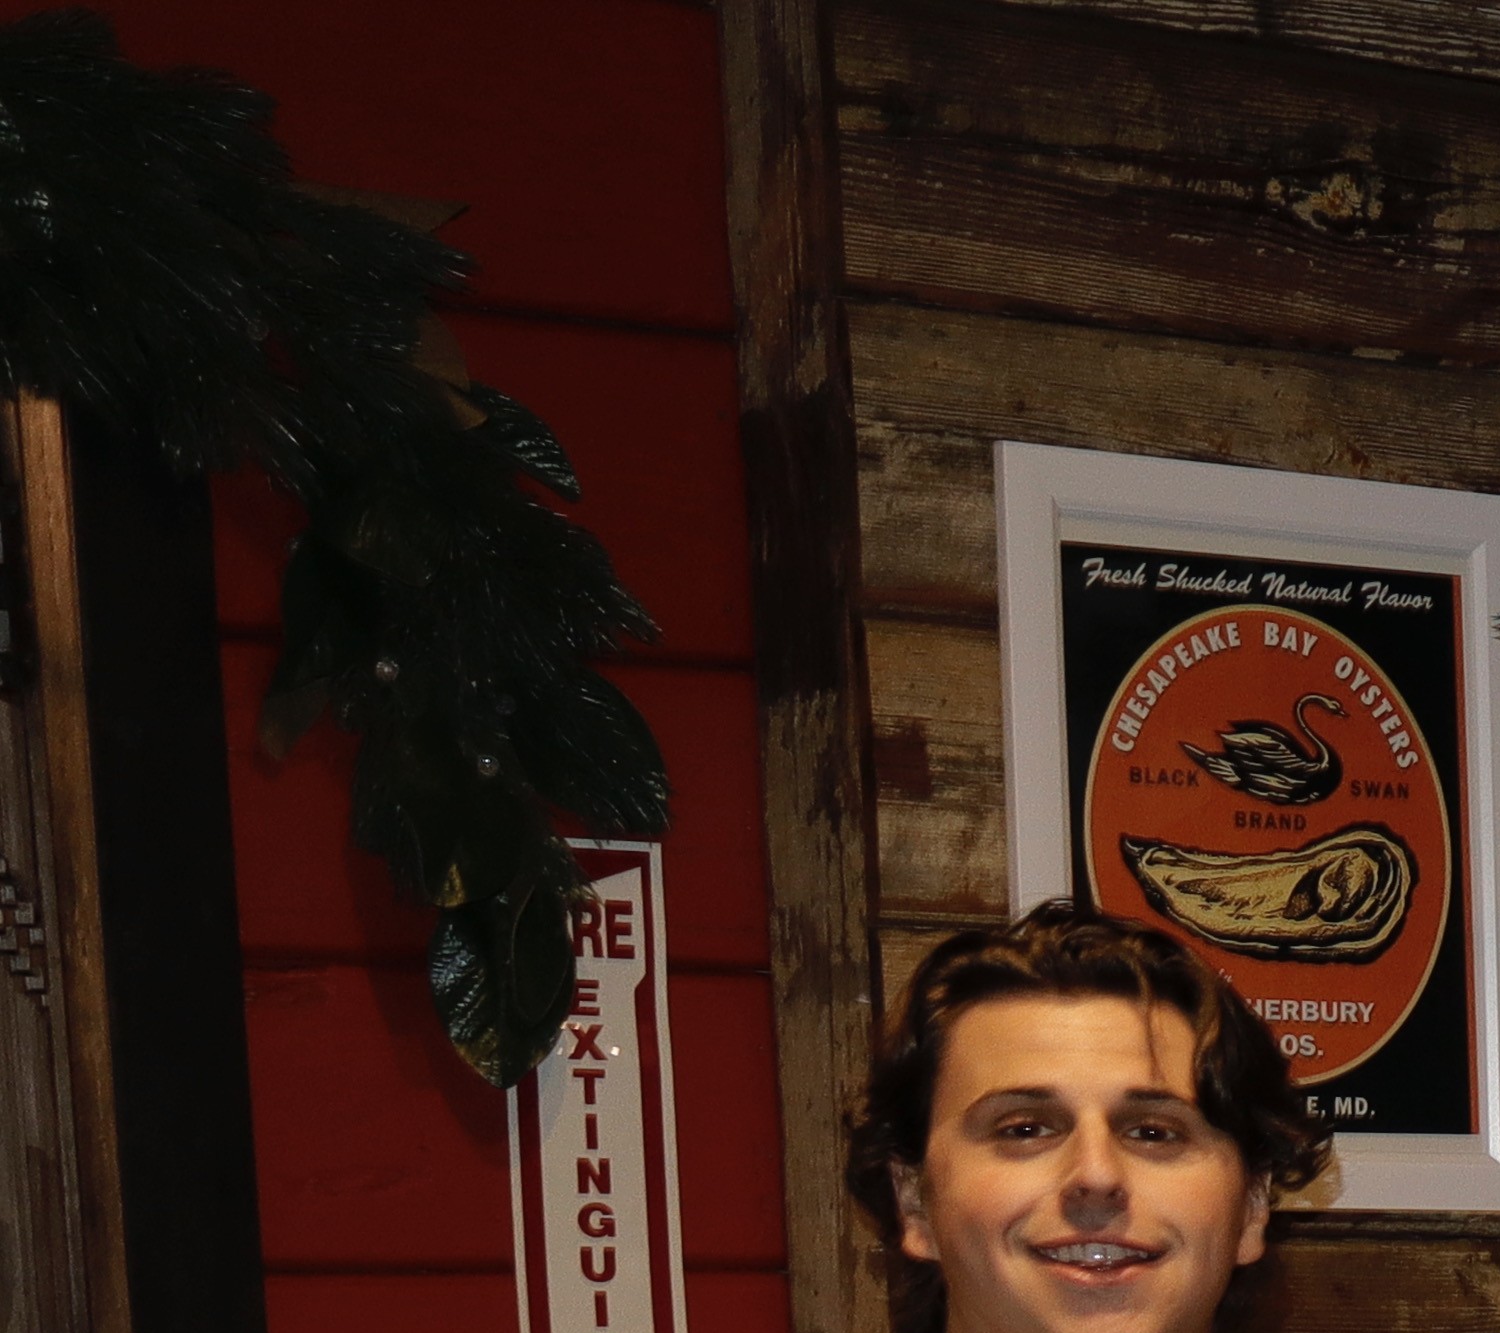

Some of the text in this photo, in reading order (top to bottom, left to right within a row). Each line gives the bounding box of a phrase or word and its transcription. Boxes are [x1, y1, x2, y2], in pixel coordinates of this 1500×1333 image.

[1081, 555, 1435, 613] Fresh Shucked Natural Flavor
[1111, 621, 1421, 770] CHESAPEAKE BAY OYSTERS
[1129, 765, 1410, 801] BLACK SWAN
[1235, 811, 1307, 832] BRAND
[572, 899, 635, 960] RE
[1246, 997, 1375, 1023] HERBURY
[1279, 1033, 1325, 1058] OS.
[1335, 1095, 1376, 1118] MD.
